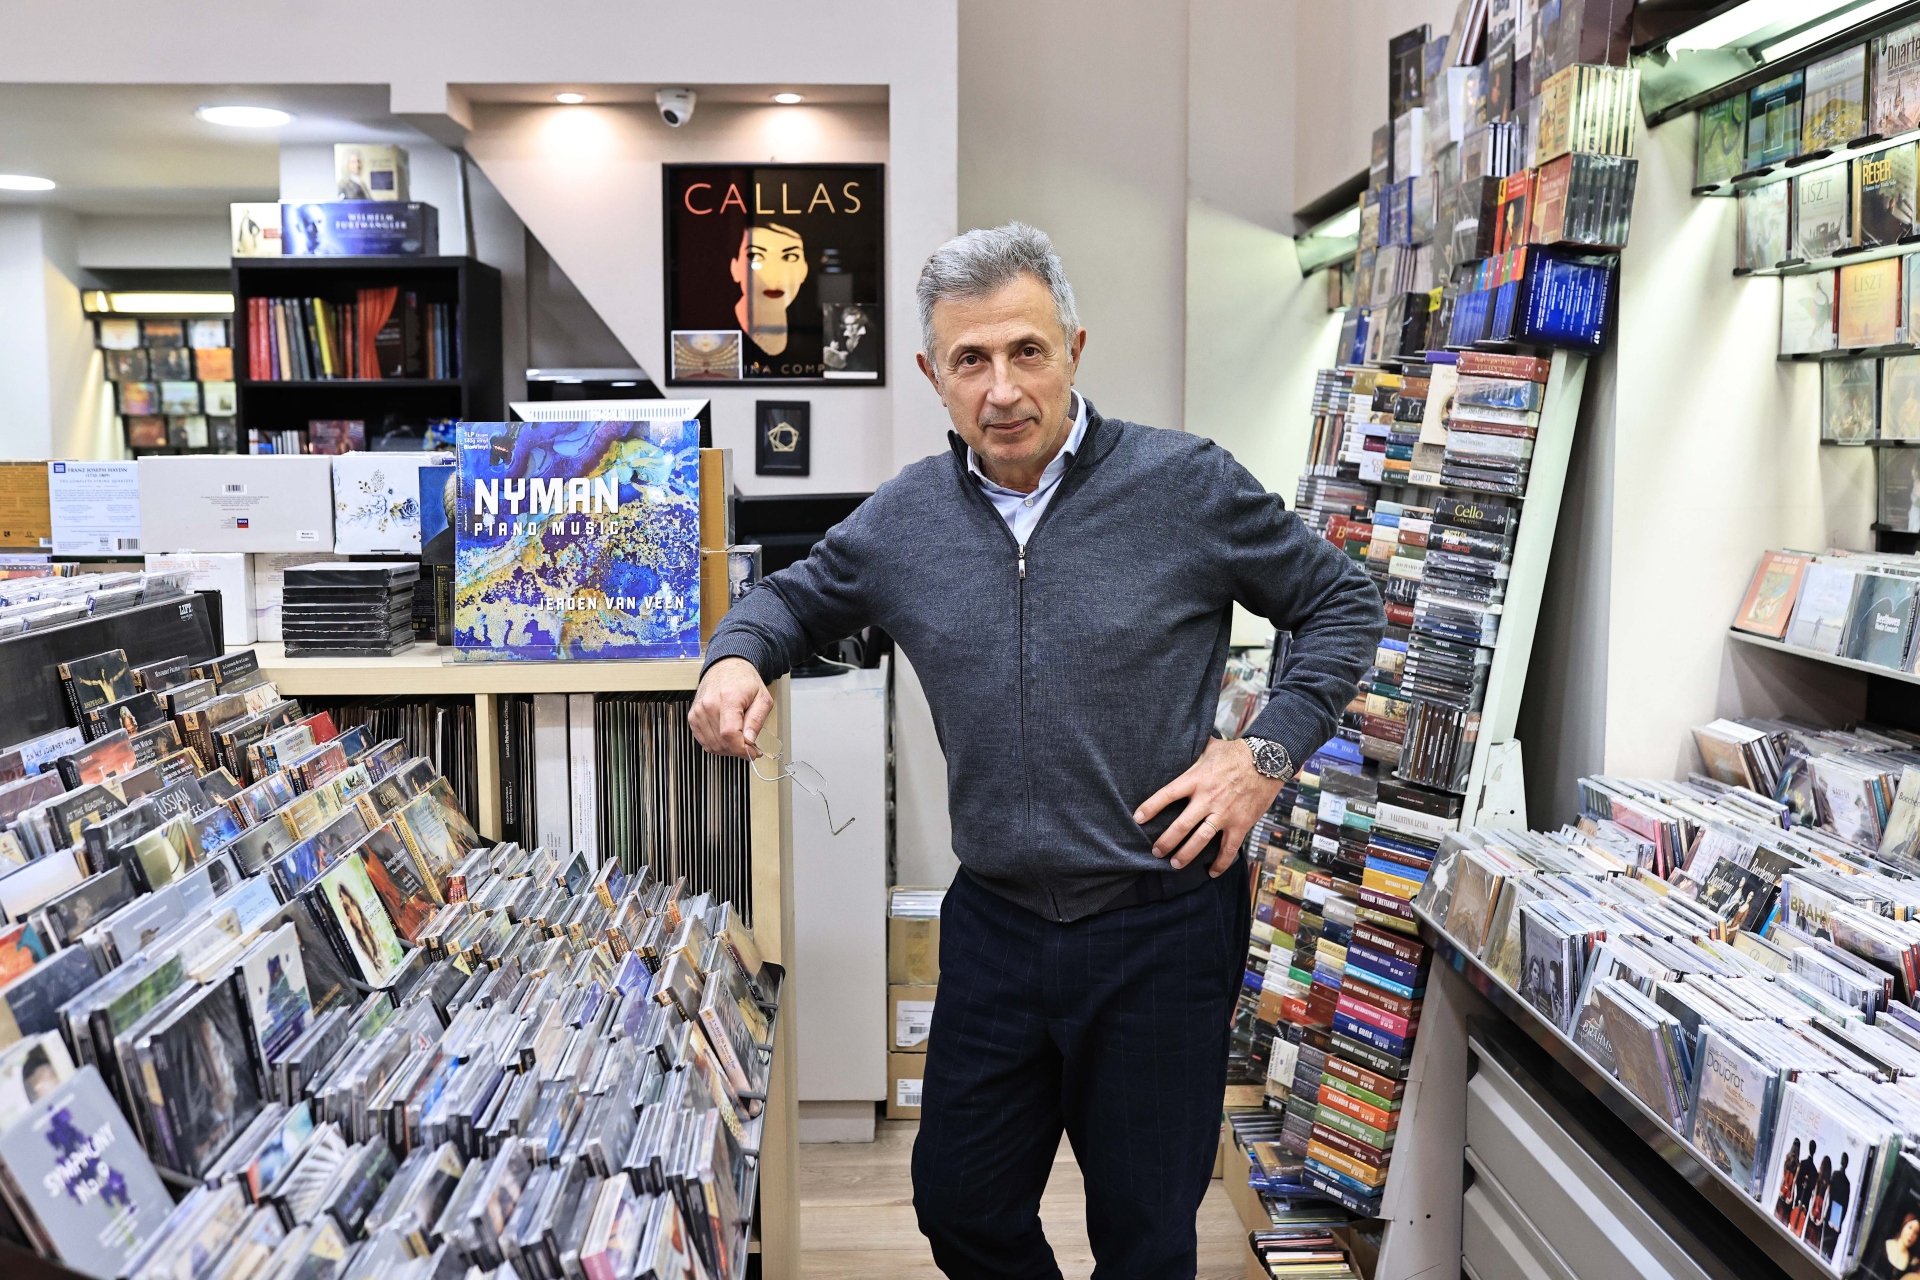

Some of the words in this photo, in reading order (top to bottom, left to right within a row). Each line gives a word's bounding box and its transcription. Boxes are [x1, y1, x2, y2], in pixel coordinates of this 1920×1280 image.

[1862, 159, 1892, 186] REGER
[685, 182, 861, 215] CALLAS
[1801, 179, 1832, 205] LISZT
[1854, 273, 1884, 293] LISZT
[473, 476, 619, 515] NYMAN
[1455, 504, 1484, 519] Cello
[474, 522, 537, 537] PIANO
[552, 521, 619, 535] MUSIC
[536, 598, 597, 611] JEROEN
[605, 597, 636, 610] VAN
[644, 596, 685, 610] VEEN
[1582, 1021, 1613, 1053] BRAHMS
[1706, 1052, 1745, 1092] Dauprat
[1793, 1100, 1820, 1131] FAURÉ
[43, 1121, 116, 1198] SYMPHONY
